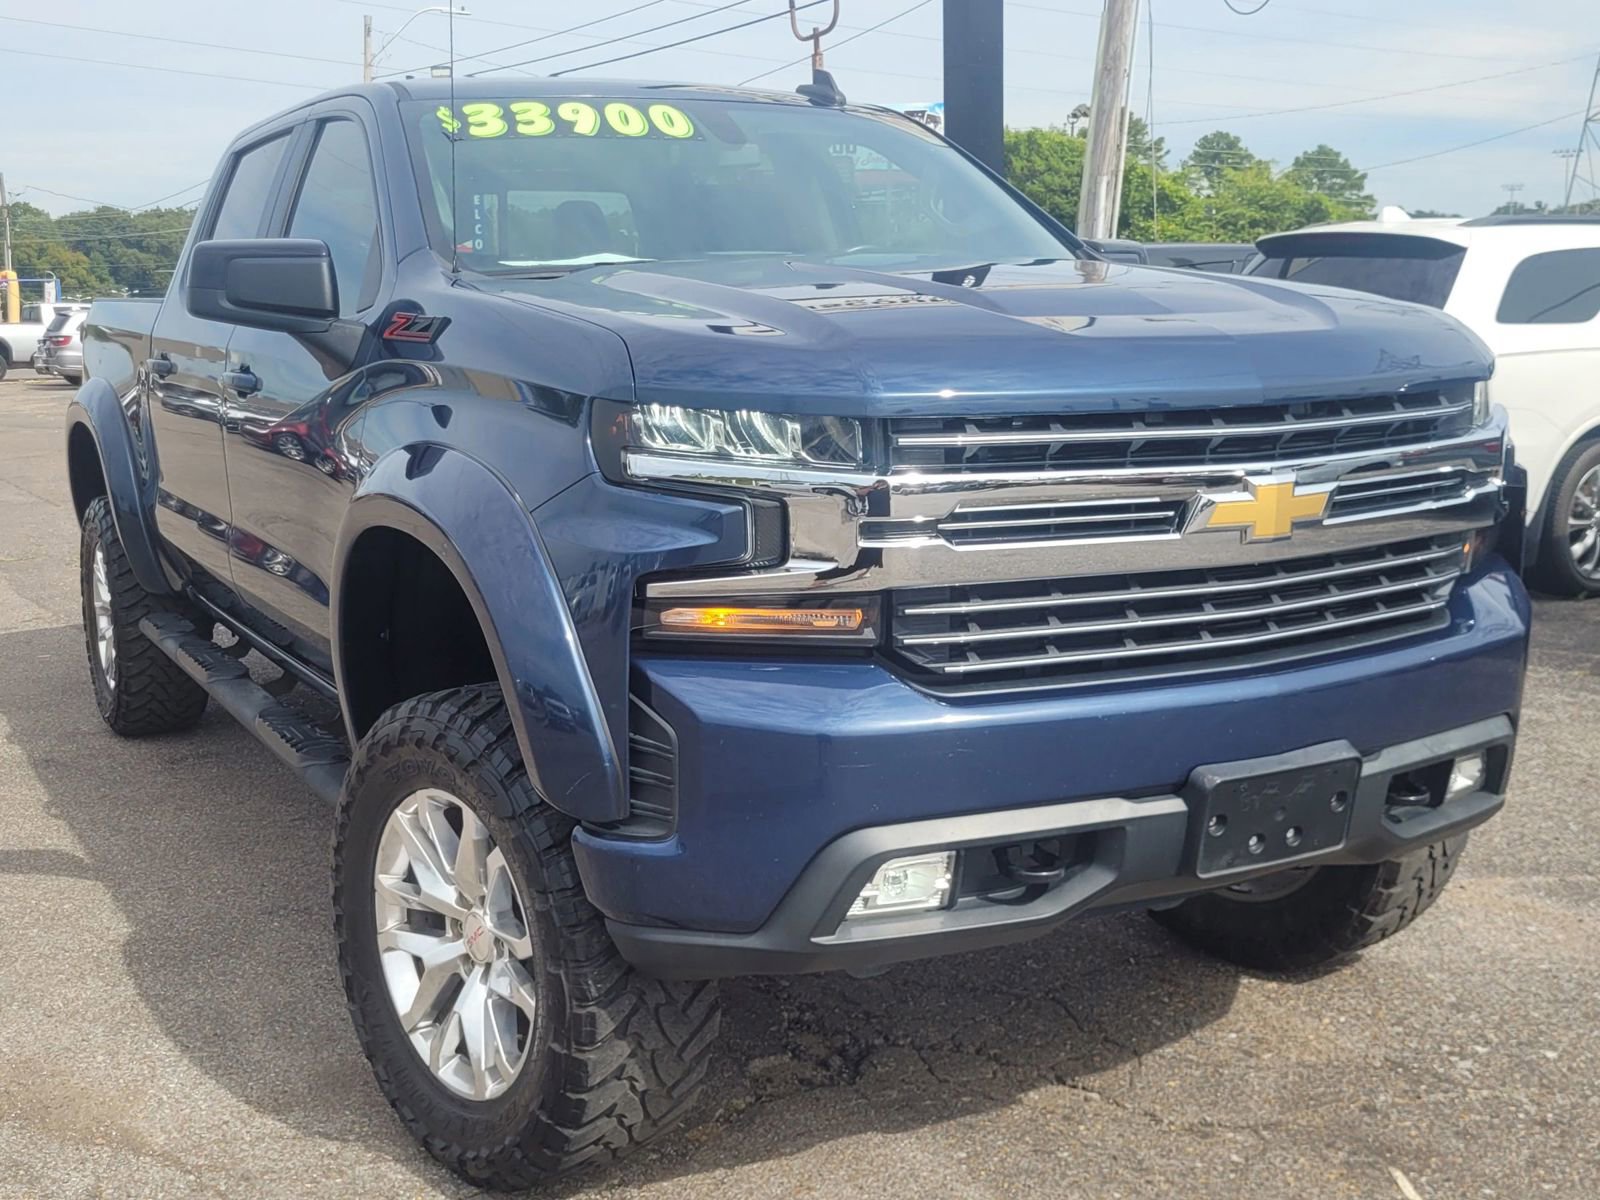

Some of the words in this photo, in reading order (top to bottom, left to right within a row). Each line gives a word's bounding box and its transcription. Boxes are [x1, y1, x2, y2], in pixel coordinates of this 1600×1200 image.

[436, 101, 695, 138] $33900
[383, 312, 445, 344] Z71
[384, 758, 456, 786] TOYO
